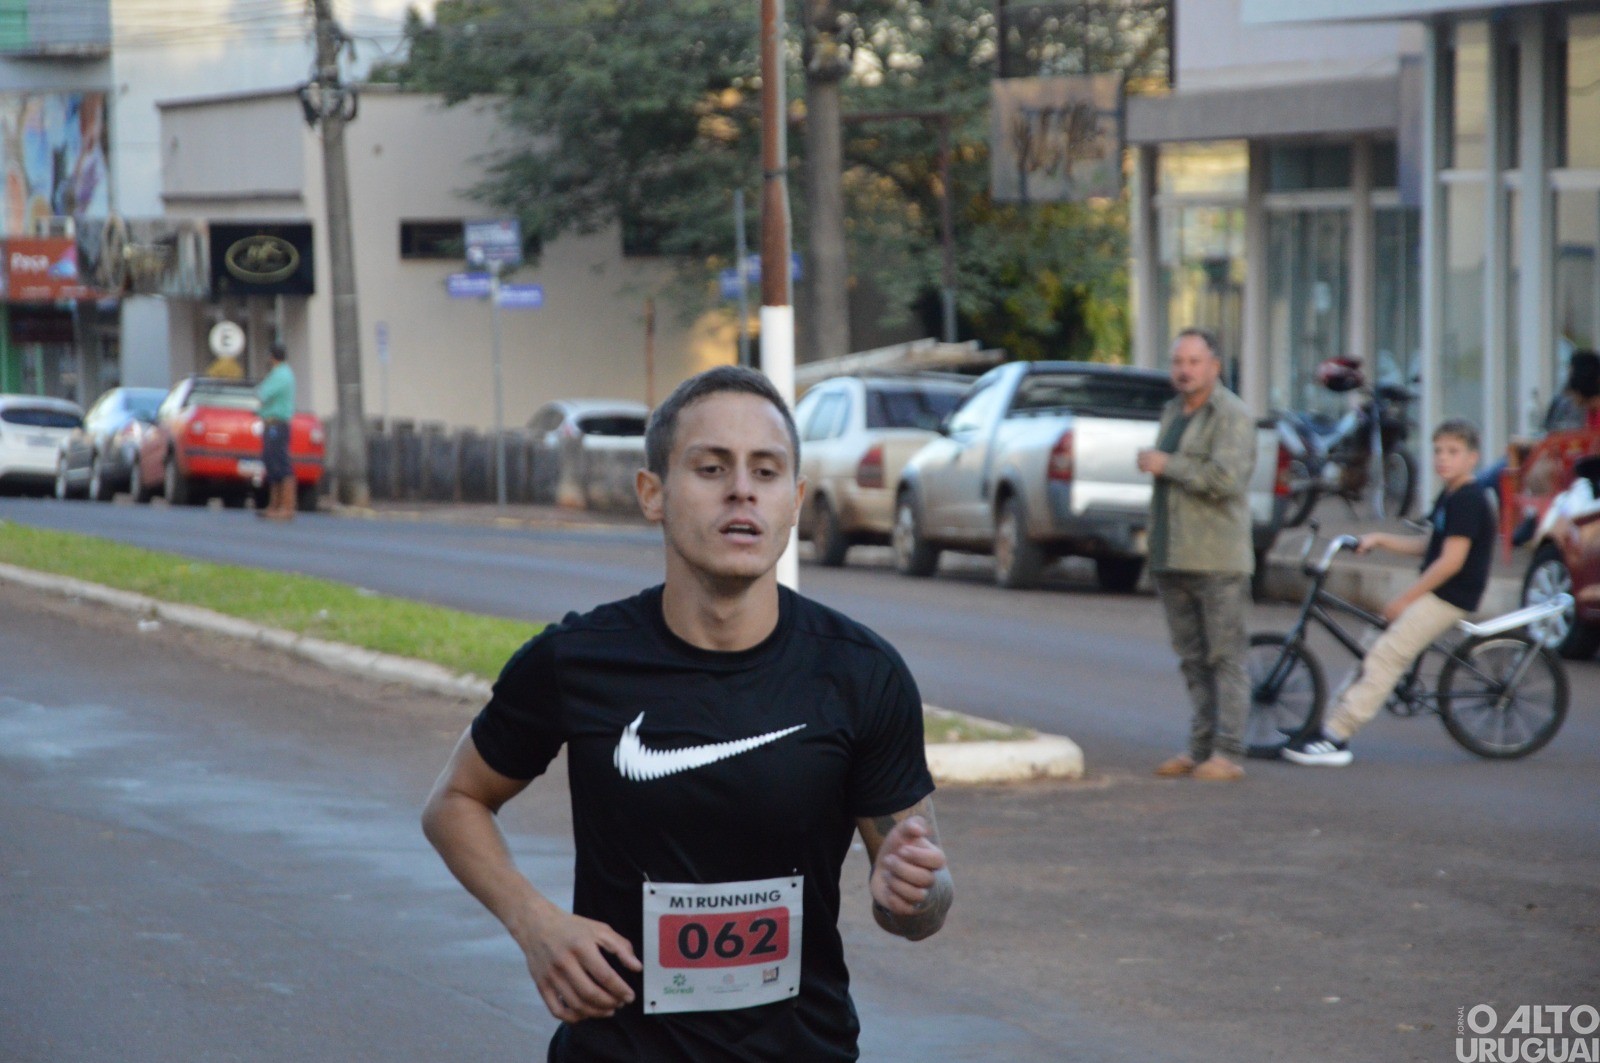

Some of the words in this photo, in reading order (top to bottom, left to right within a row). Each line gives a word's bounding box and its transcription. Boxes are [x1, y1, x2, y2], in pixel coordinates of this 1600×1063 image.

[222, 327, 234, 347] E
[669, 890, 781, 908] M1RUNNING
[677, 918, 778, 960] 062
